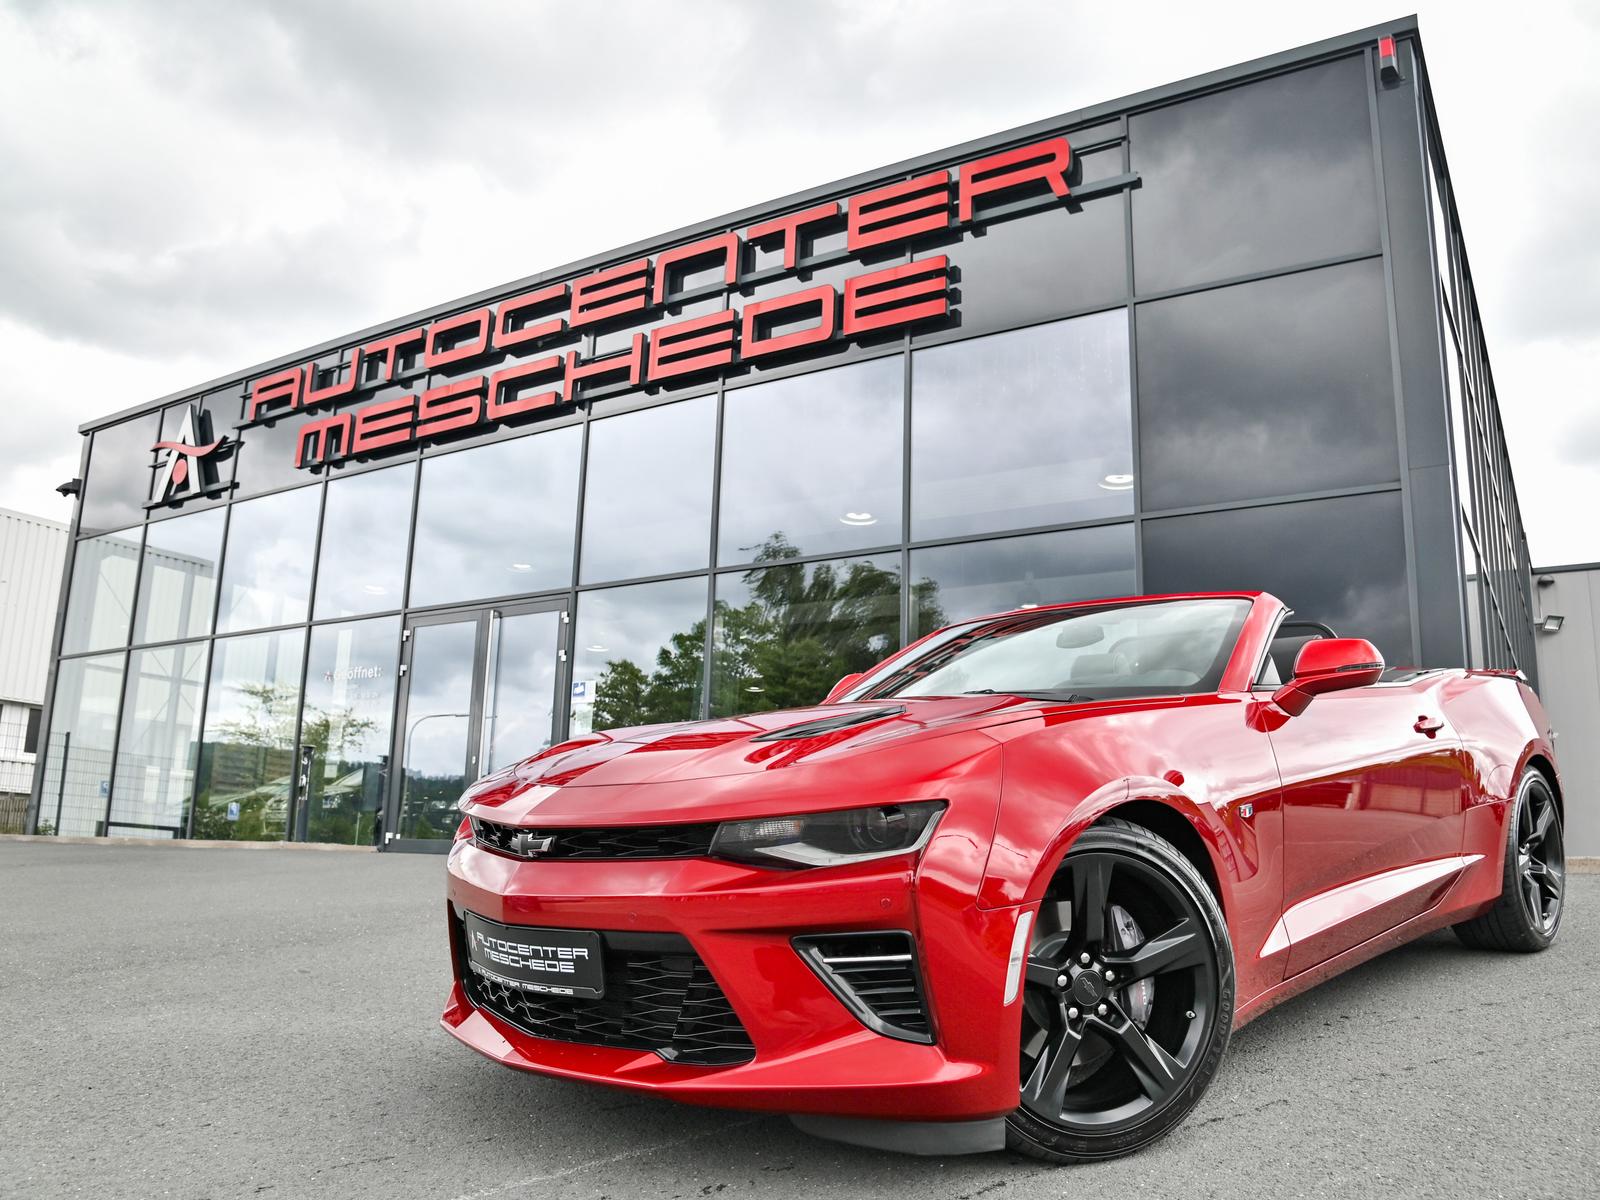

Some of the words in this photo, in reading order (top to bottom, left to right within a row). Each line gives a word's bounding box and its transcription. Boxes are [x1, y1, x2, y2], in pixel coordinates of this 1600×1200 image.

[249, 136, 1071, 423] AUTOCENTER
[294, 254, 948, 469] MESCHEDE
[476, 931, 589, 960] AUTOCENTER
[484, 947, 575, 973] MESCHEDE
